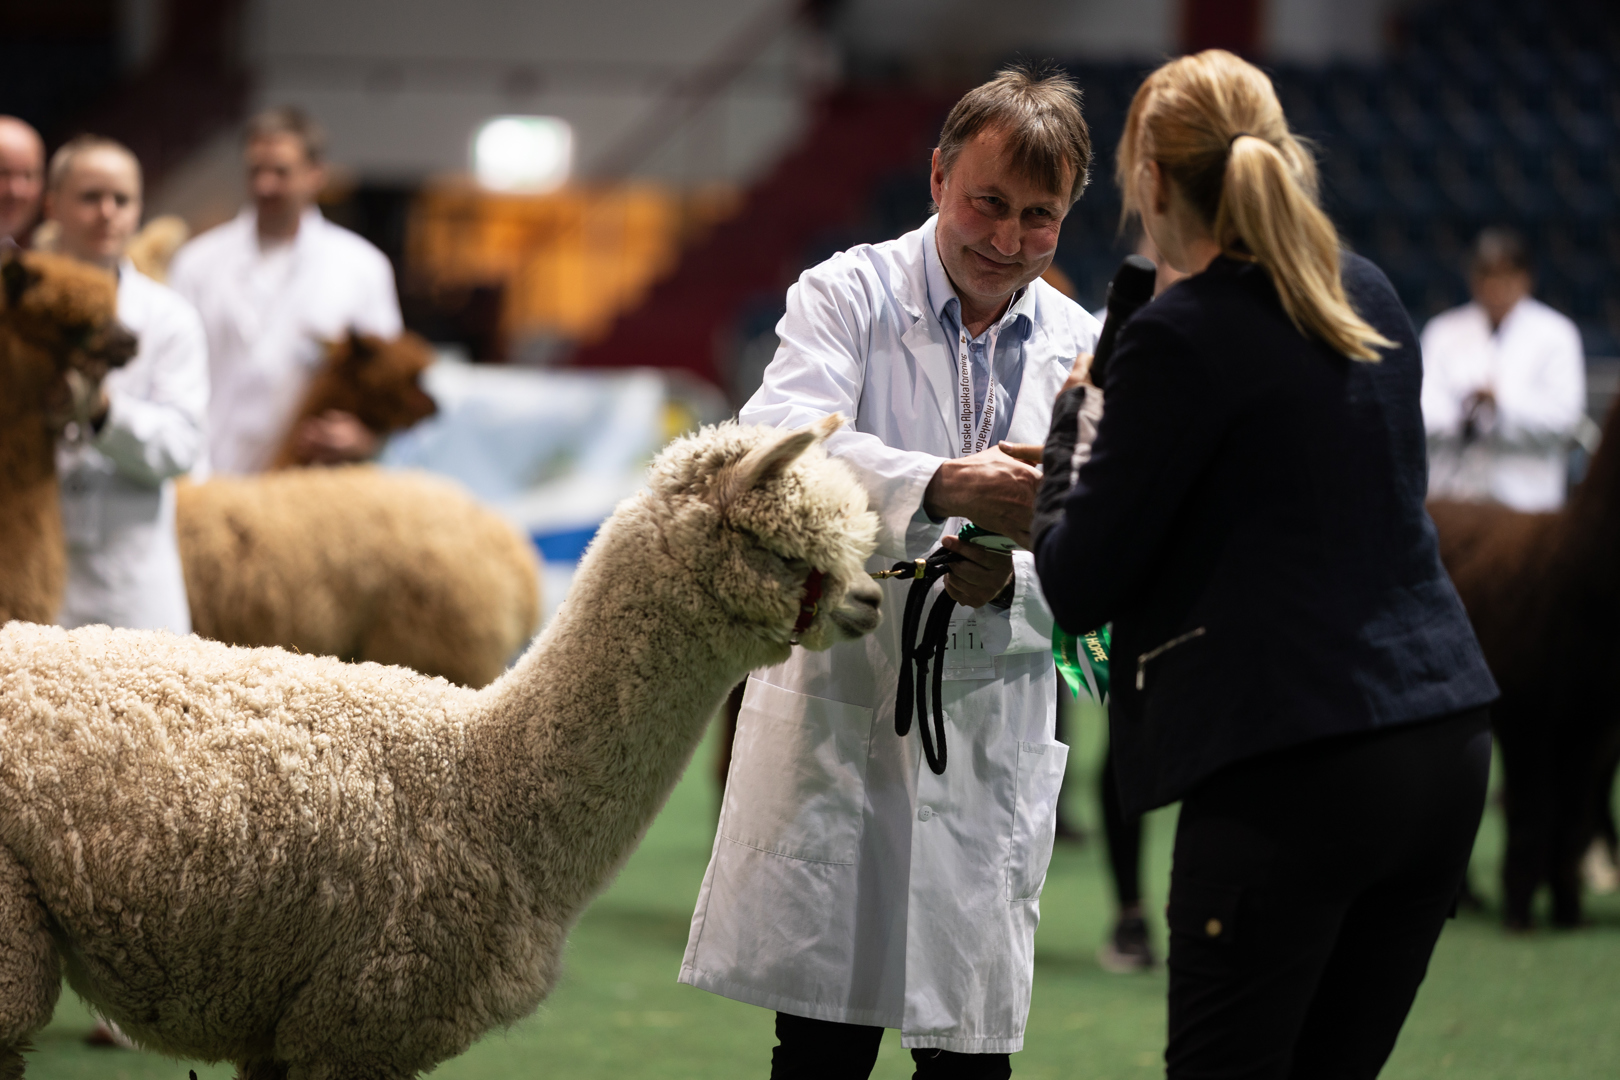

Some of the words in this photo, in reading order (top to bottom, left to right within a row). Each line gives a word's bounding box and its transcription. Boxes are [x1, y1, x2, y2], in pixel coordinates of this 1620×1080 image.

[961, 423, 972, 454] Norske
[975, 404, 995, 453] Alpakkafor
[1085, 637, 1109, 662] HOPPE
